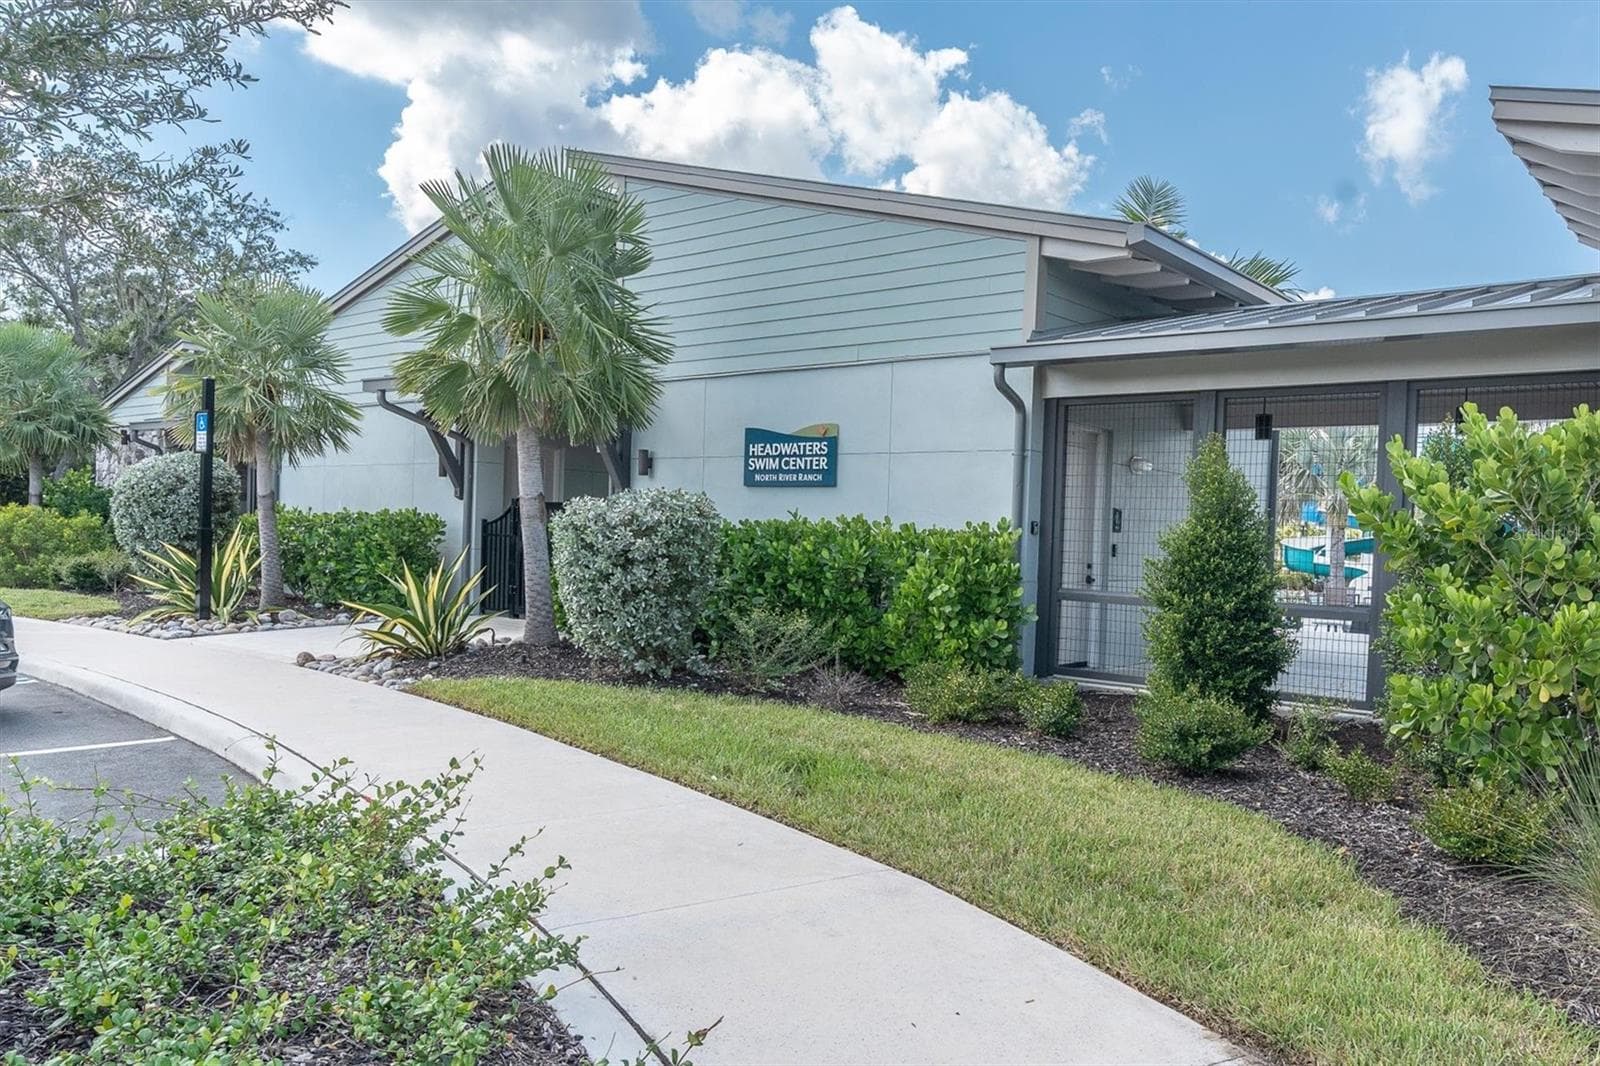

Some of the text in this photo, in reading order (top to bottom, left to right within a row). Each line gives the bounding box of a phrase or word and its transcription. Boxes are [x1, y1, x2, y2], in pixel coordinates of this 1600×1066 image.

[749, 442, 828, 456] HEADWATERS
[748, 457, 828, 470] SWIM CENTER
[754, 473, 823, 482] NORTH RIVER RANCH
